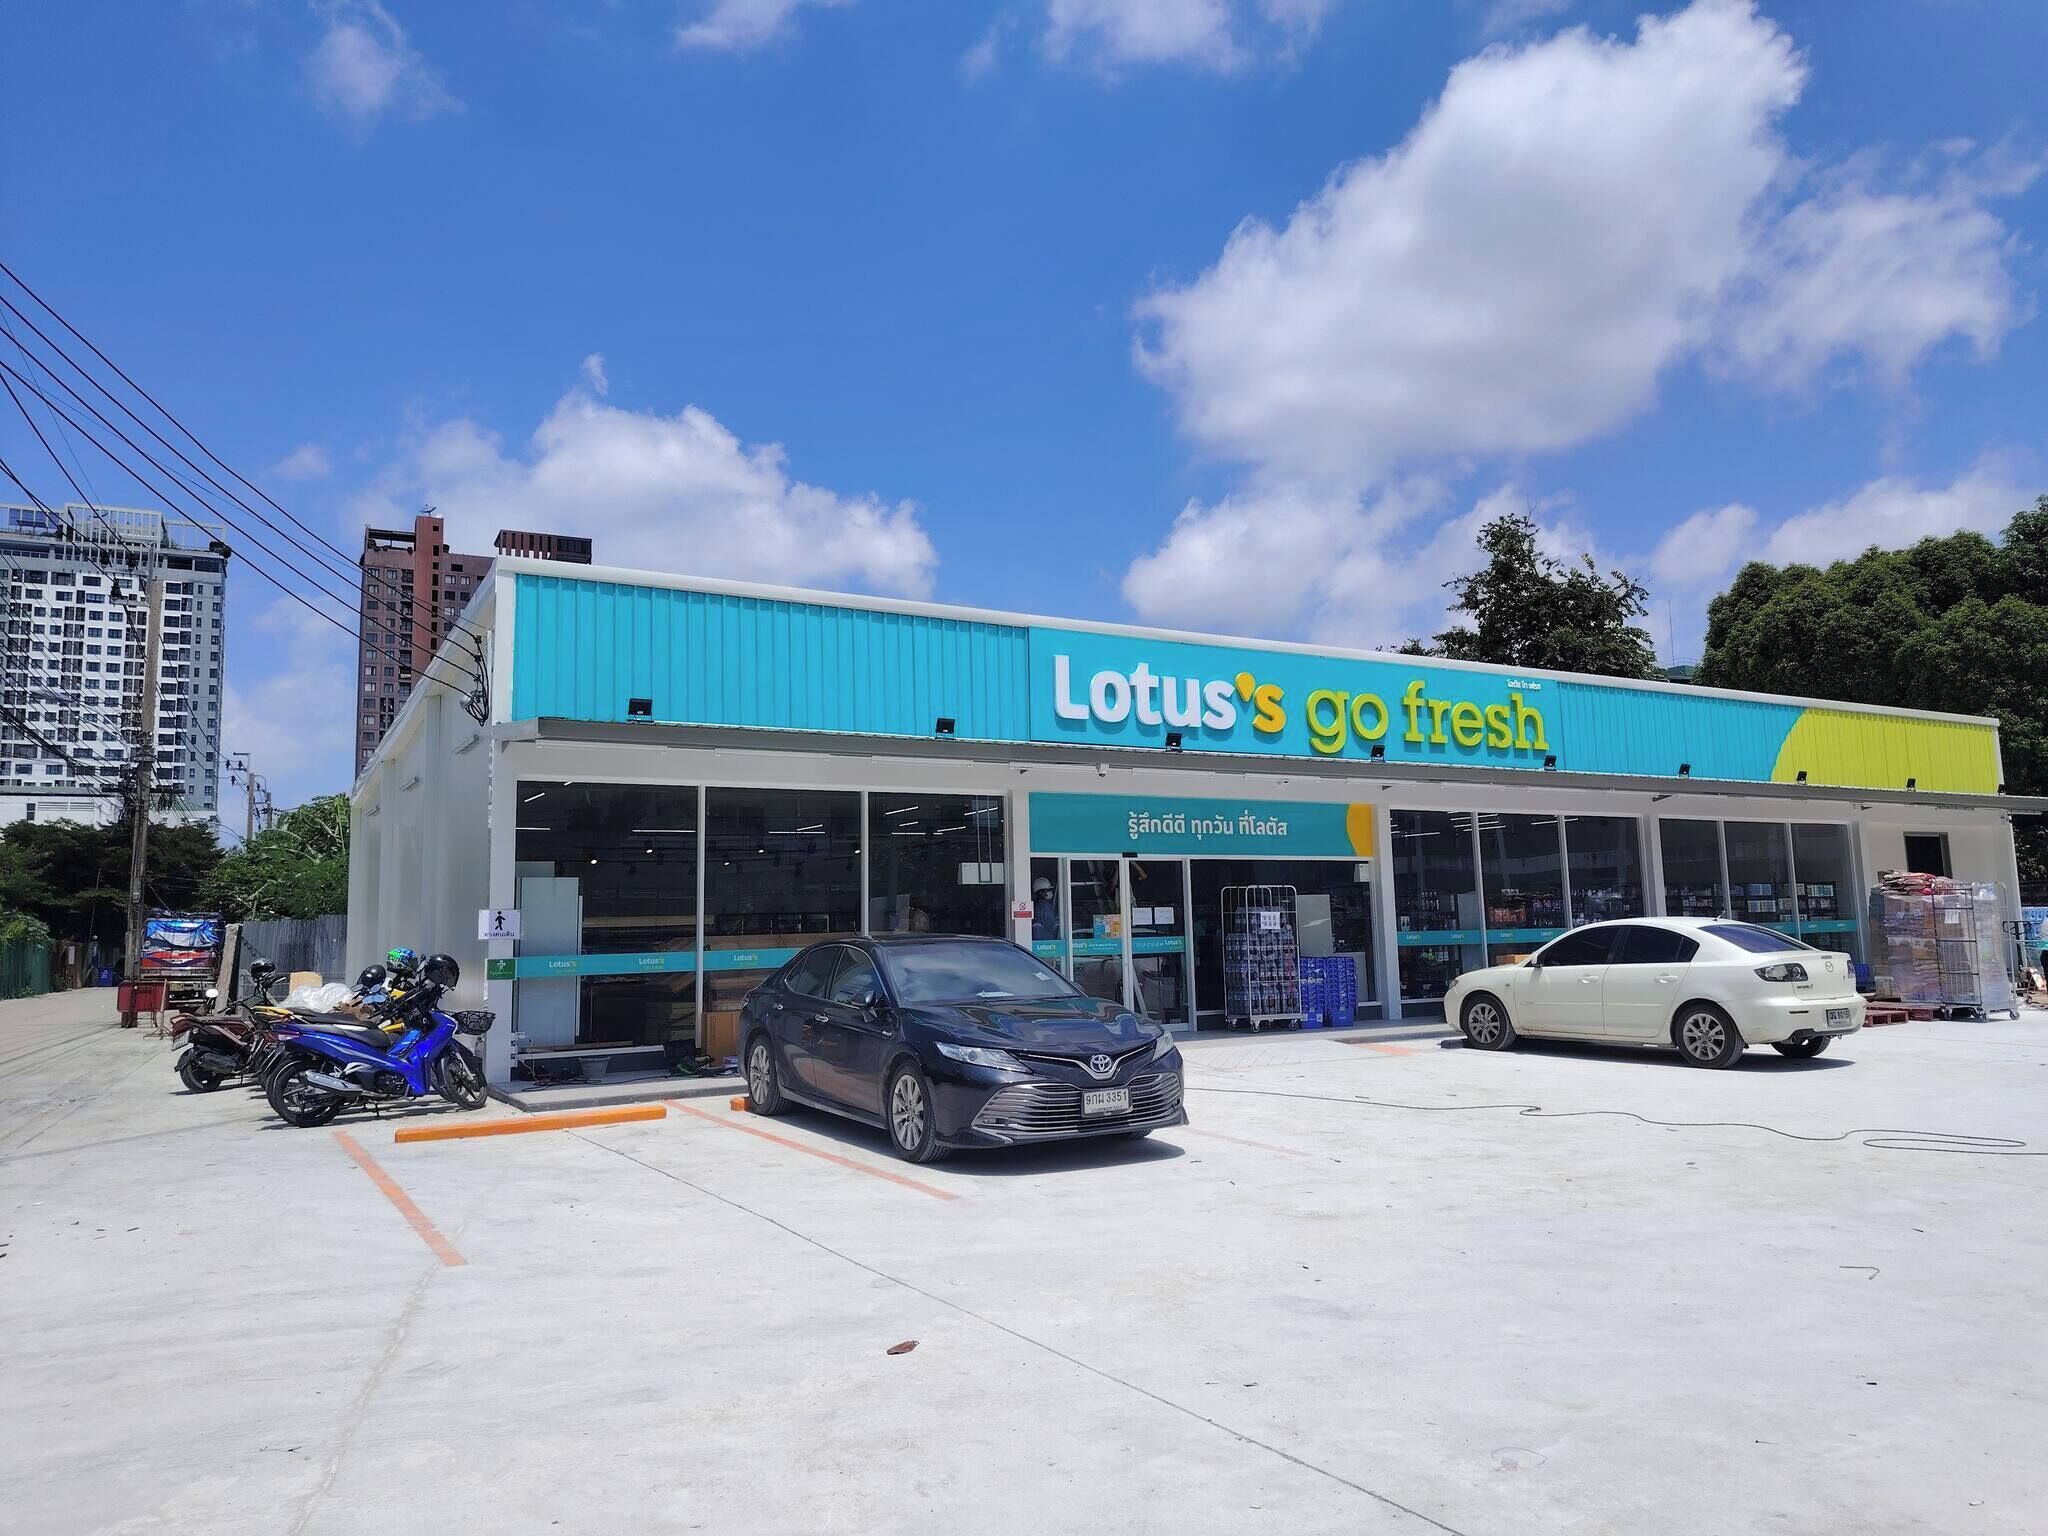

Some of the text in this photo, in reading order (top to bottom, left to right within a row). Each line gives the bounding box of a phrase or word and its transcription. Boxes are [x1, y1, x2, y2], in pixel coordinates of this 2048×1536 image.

[1053, 654, 1550, 754] Lotus's go fresh
[1191, 814, 1234, 840] ทุกวัน
[1238, 809, 1288, 836] ที่โลตัส
[1106, 1090, 1127, 1103] 3351
